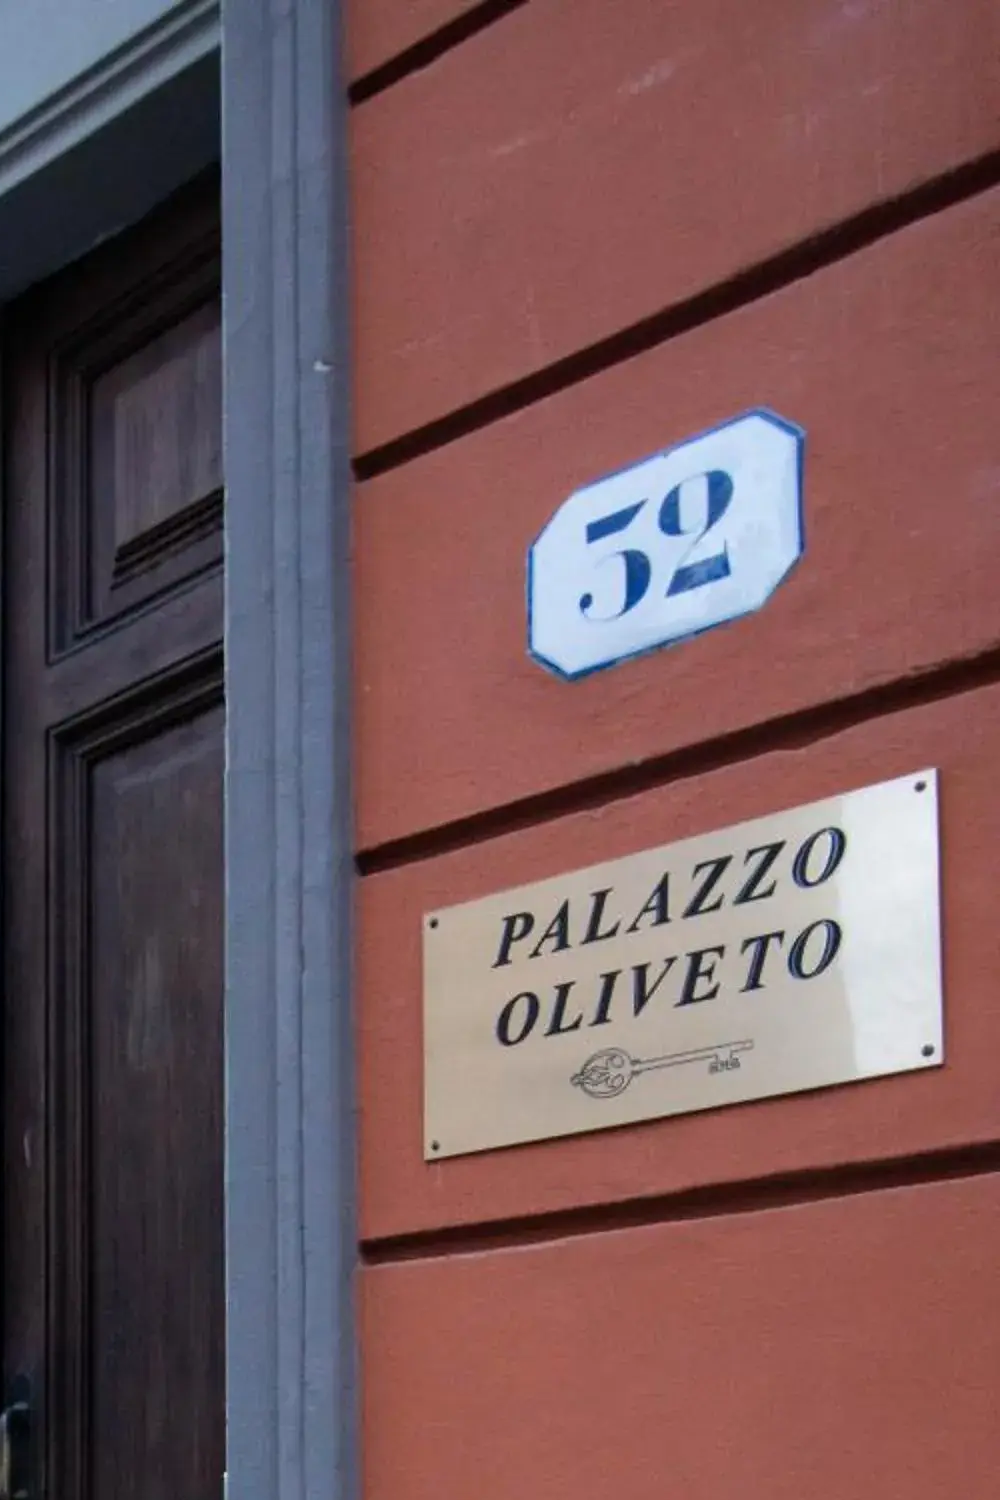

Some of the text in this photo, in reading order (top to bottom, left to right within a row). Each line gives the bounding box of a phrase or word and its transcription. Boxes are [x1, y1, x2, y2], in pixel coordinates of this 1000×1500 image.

[579, 469, 734, 621] 52
[492, 826, 846, 968] PALAZZO
[496, 919, 843, 1046] OLIVETO
